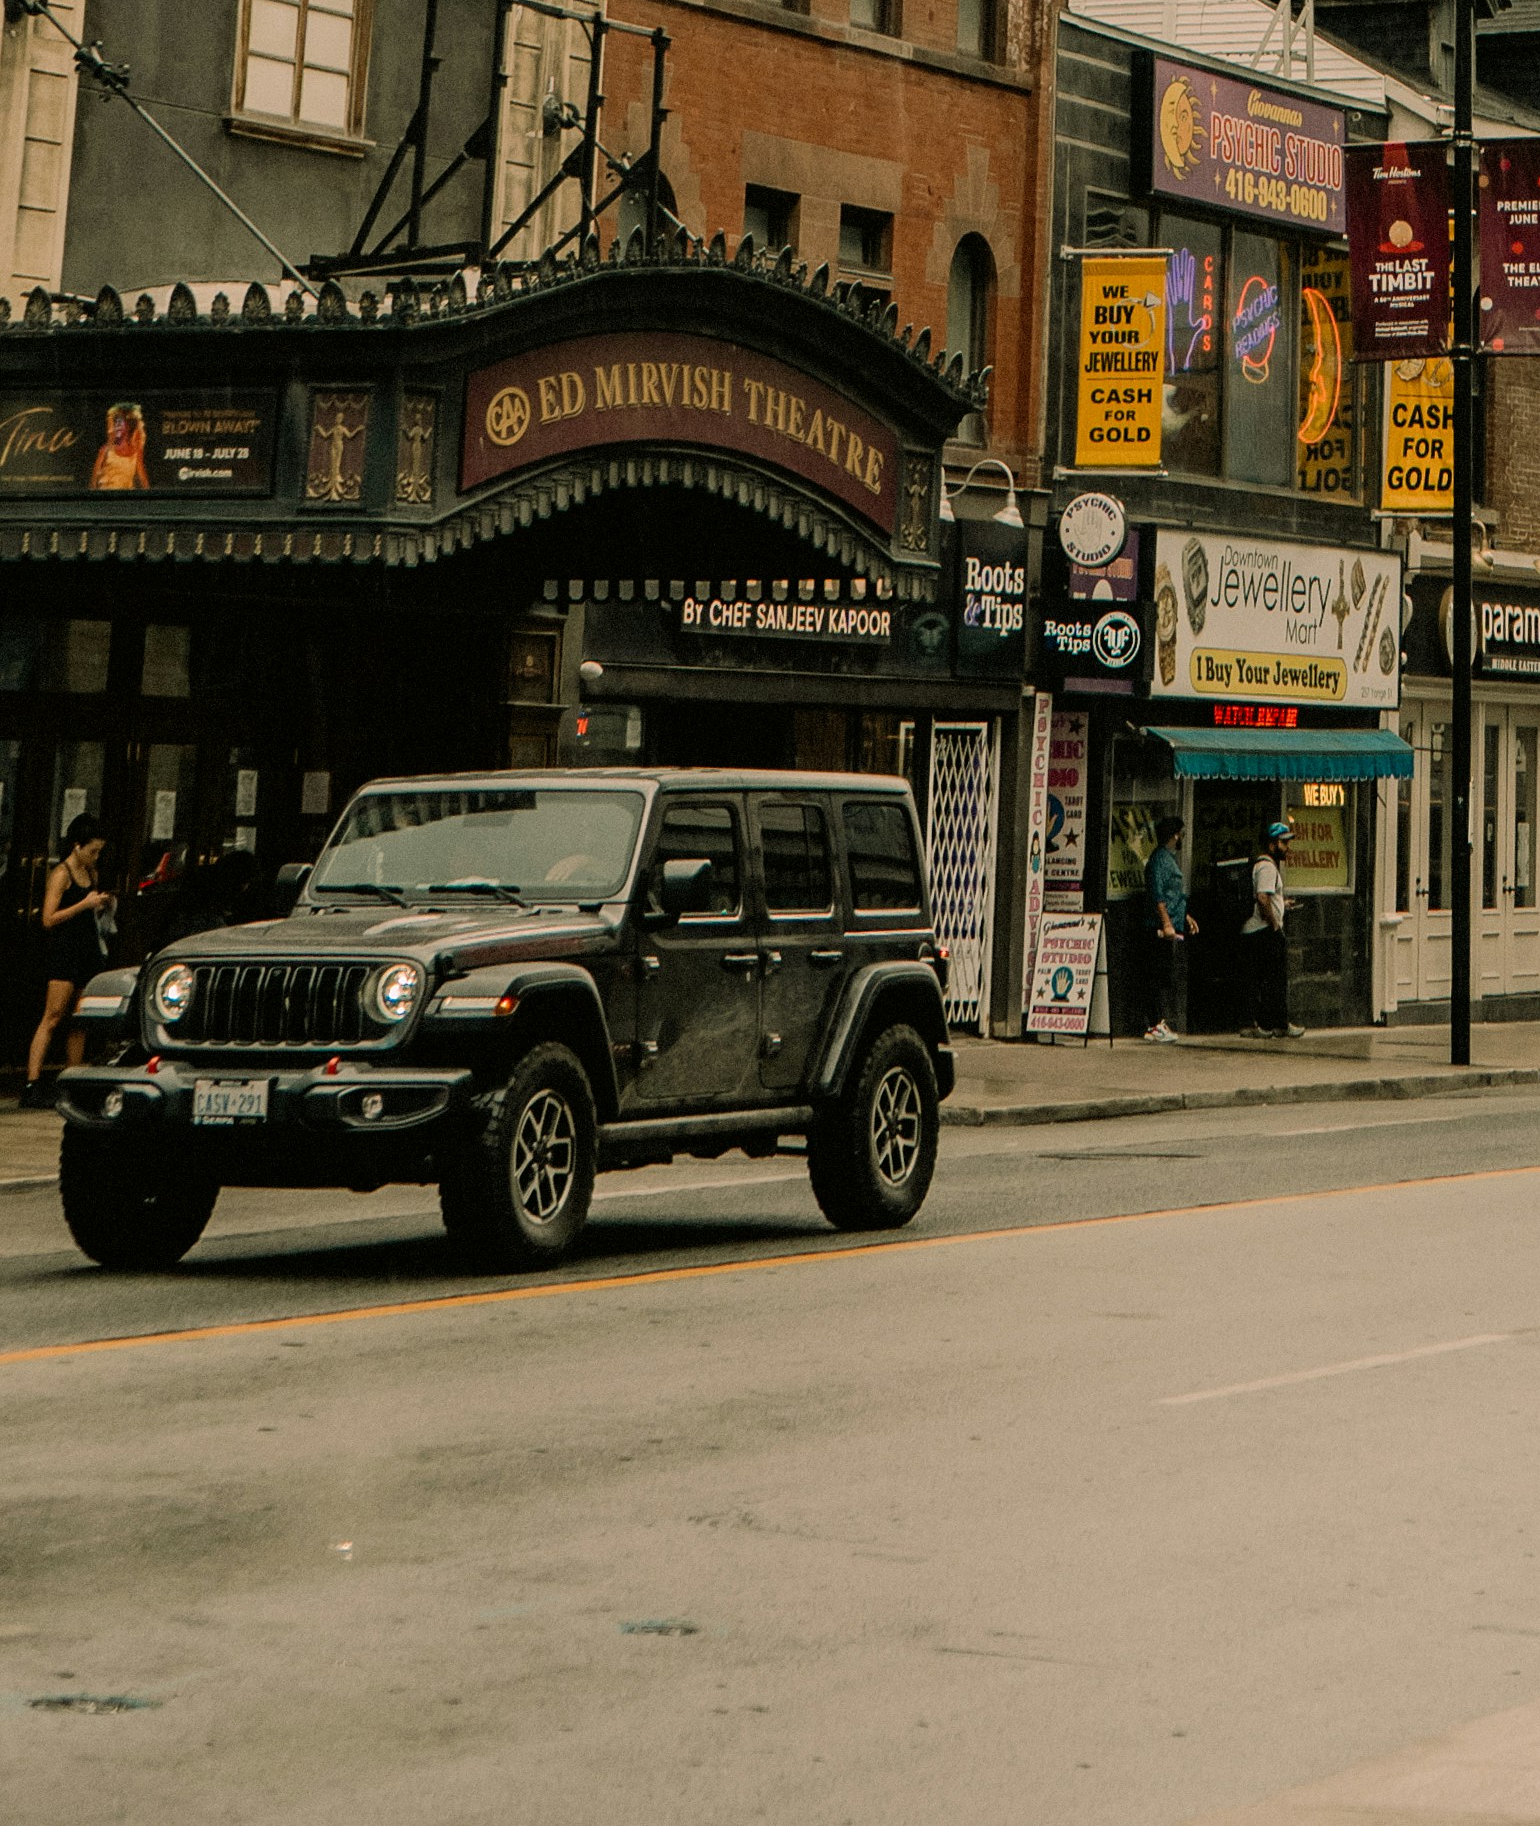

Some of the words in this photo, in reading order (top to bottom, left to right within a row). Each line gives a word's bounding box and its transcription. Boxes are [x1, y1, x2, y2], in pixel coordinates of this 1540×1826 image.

[1210, 111, 1281, 176] PSYCHIC
[1285, 132, 1342, 191] STUDIO
[1372, 167, 1389, 180] Tim
[1389, 166, 1422, 179] Hortons
[1225, 167, 1328, 222] 416-943-0600
[1509, 213, 1538, 225] JUNE
[1375, 261, 1394, 272] THE
[1394, 258, 1428, 273] LAST
[1503, 262, 1525, 274] THE
[1102, 285, 1129, 299] WE
[1369, 271, 1435, 292] TIMBIT
[1095, 305, 1134, 325] BUY
[1089, 330, 1139, 344] YOUR
[1085, 351, 1159, 373] JEWELLERY
[1091, 388, 1152, 404] CASH
[1104, 410, 1136, 421] FOR
[0, 407, 79, 467] Tina
[492, 392, 527, 439] CAA
[538, 371, 586, 424] ED
[594, 362, 732, 416] MIRVISH
[743, 377, 884, 496] THEATRE
[1089, 427, 1151, 443] GOLD
[164, 448, 191, 459] JUNE
[212, 447, 235, 459] JULY
[1403, 437, 1443, 459] FOR
[1066, 498, 1117, 521] PSYCHIC
[1066, 541, 1111, 562] STUDIO
[1224, 545, 1279, 571] Downtown
[964, 556, 1025, 595] Roots
[1211, 555, 1332, 628] Jewellery
[709, 599, 752, 627] CHEF
[756, 603, 824, 633] SANJEEV
[828, 608, 891, 637] KAPOOR
[1044, 620, 1092, 637] Roots
[1285, 618, 1319, 645] Mart
[1056, 635, 1092, 655] Tips
[1196, 655, 1202, 681] I
[1205, 656, 1232, 688] Buy
[1236, 657, 1270, 685] Your
[1273, 660, 1341, 695] Jewellery
[1491, 658, 1517, 671] MIDDLE
[1031, 699, 1049, 826] PSYCHIC
[1304, 783, 1319, 806] WE
[1320, 783, 1338, 806] BUY
[1042, 938, 1095, 950] PSYCHIC
[1041, 951, 1092, 964] STUDIO
